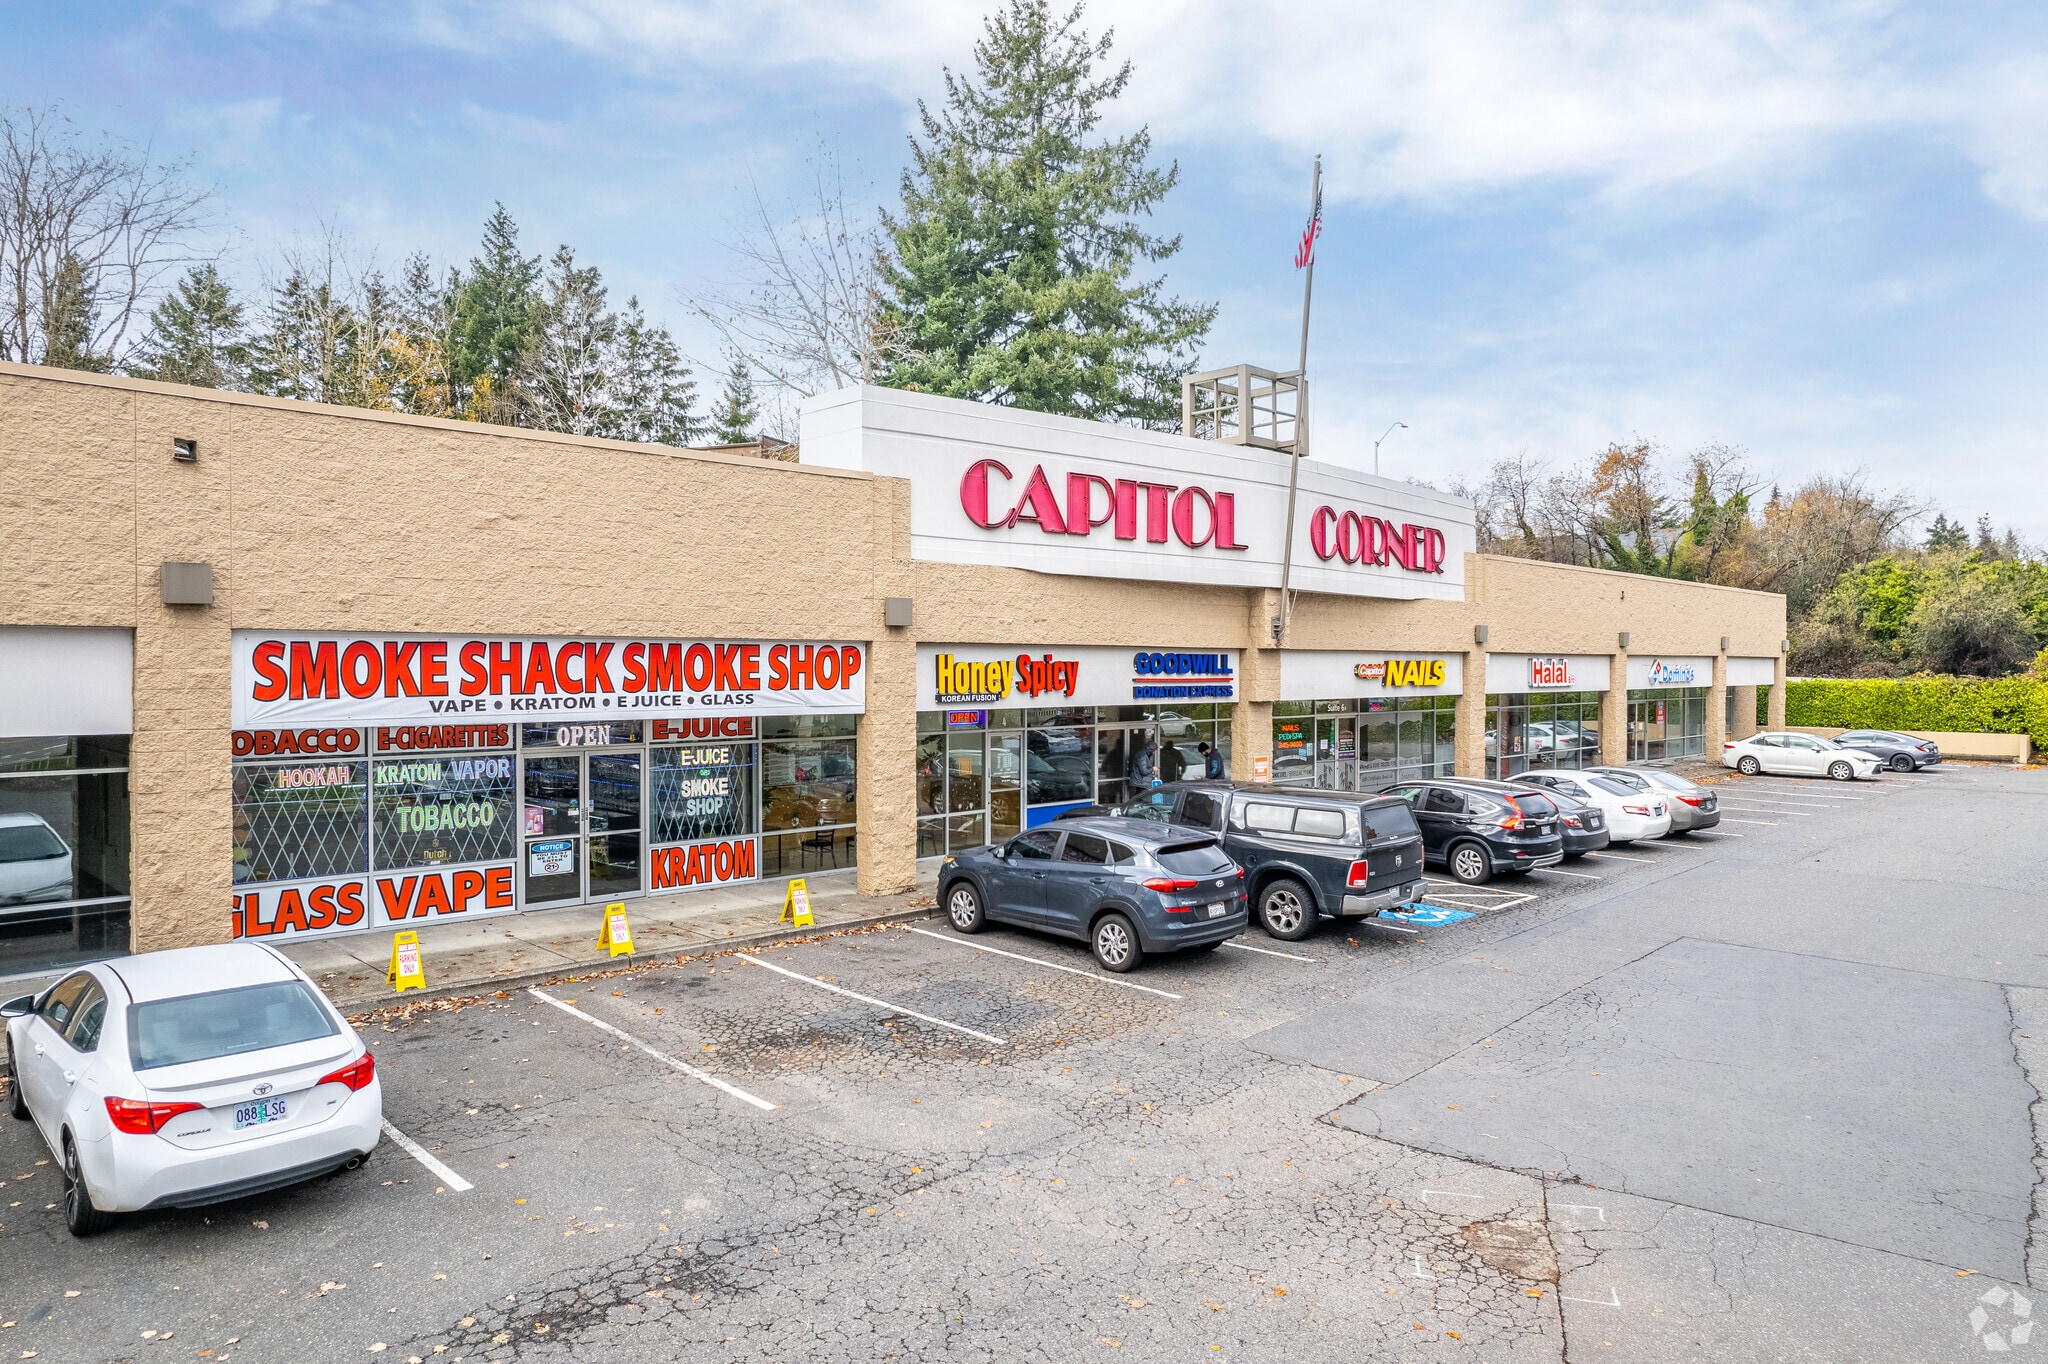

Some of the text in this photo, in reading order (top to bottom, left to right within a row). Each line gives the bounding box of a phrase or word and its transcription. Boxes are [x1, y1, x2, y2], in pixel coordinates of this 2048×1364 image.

[959, 458, 1446, 574] CAPITOL CORNER
[252, 640, 861, 701] SMOKE SHACK SMOKE SHOP
[1134, 652, 1233, 675] GOODWILL
[1359, 660, 1446, 687] Capitol NAILS
[1533, 661, 1567, 684] Halal
[937, 654, 1079, 698] Honey Spicy
[429, 693, 754, 713] VAPE KRATOM E JUICE GLASS
[941, 694, 997, 703] KOREAN FUSION
[1133, 685, 1234, 699] DONATION EXPRESS
[949, 712, 978, 724] OPEN
[1327, 704, 1340, 712] Suite
[377, 724, 510, 751] E-CIGARETTES
[556, 725, 611, 747] OPEN
[652, 717, 753, 740] E-JUICE
[1281, 724, 1300, 732] NAILS
[232, 728, 360, 756] OBACCO
[681, 748, 729, 766] E-JUICE
[278, 766, 350, 788] HOOKAH
[377, 759, 511, 784] KRATOM VAPOR
[681, 778, 729, 798] SMOKE
[397, 801, 494, 833] TOBACCO
[686, 797, 724, 816] SHOP
[423, 849, 447, 860] Dutch
[651, 839, 755, 890] KRATOM
[376, 866, 513, 921] VAPE
[236, 1100, 286, 1123] 088 LSG
